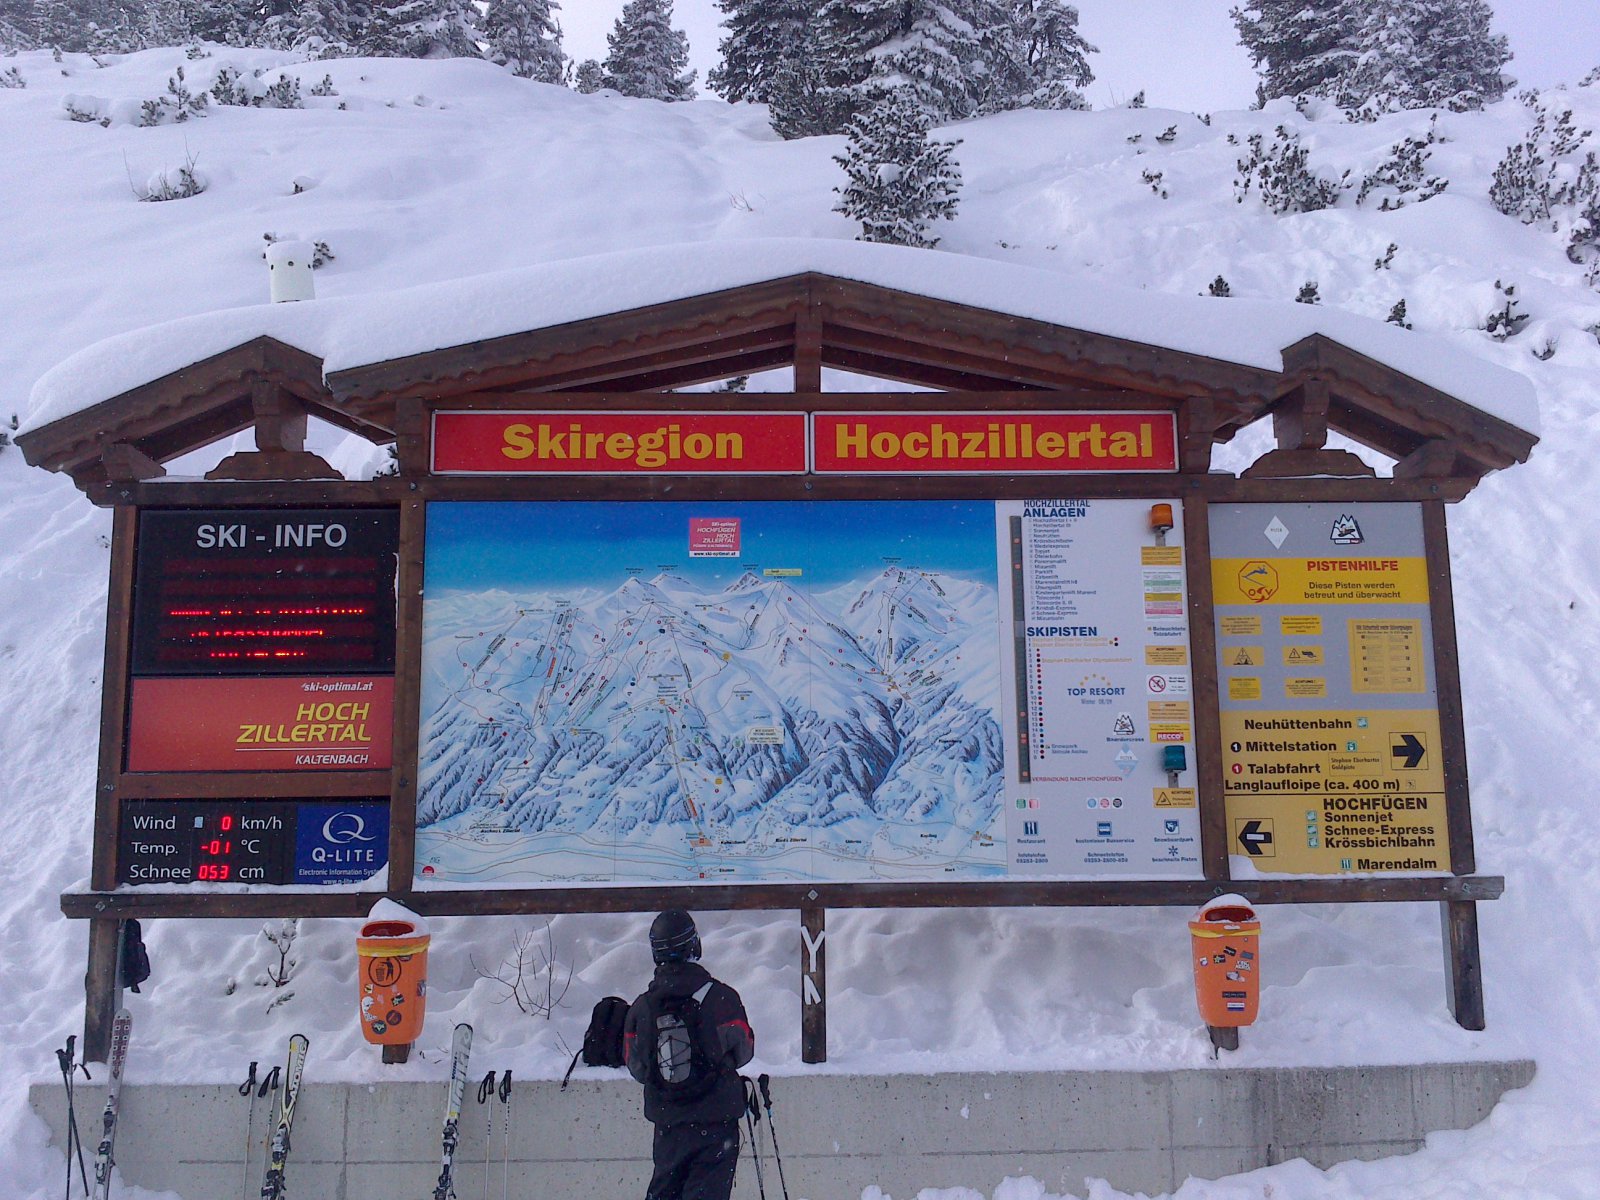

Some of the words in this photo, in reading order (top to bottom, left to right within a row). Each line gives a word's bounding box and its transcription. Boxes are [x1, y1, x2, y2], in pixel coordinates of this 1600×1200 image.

[501, 423, 743, 468] Skiregion
[835, 423, 1153, 459] Hochzillertal
[1023, 499, 1091, 508] HOCHZILLERTAL
[1023, 508, 1086, 518] ANLAGEN
[196, 524, 247, 548] SKI
[275, 523, 348, 548] INFO
[1307, 560, 1399, 572] PISTENHILFE
[1309, 581, 1333, 589] Diese
[1335, 581, 1362, 589] Pisten
[1363, 581, 1396, 589] werden
[1304, 590, 1335, 599] betreut
[1337, 590, 1354, 599] und
[1355, 590, 1401, 599] überwacht
[1026, 626, 1098, 637] SKIPISTEN
[1067, 688, 1087, 696] TOP
[1089, 687, 1126, 696] RESORT
[296, 702, 370, 722] HOCH
[1244, 718, 1353, 730] Neuhüttenbahn
[236, 723, 372, 743] ZILLERTAL
[1246, 741, 1337, 752] Mittelstation
[295, 754, 369, 765] KALTENBACH
[1248, 763, 1321, 774] Talabfahrt
[1225, 779, 1321, 792] Langlaufloipe
[1324, 779, 1350, 791] (ca.
[1353, 779, 1380, 790] 400
[1383, 779, 1400, 791] m)
[1323, 795, 1428, 811] HOCHFÜGEN
[133, 815, 176, 830] Wind
[221, 815, 232, 831] 0
[241, 815, 283, 830] km/h
[1324, 811, 1394, 824] Sonnenjet
[1325, 824, 1435, 838] Schnee-Express
[131, 841, 179, 856] Temp.
[201, 840, 231, 855] -01
[240, 839, 260, 854] °C
[1325, 836, 1436, 848] Krössbichlbahn
[311, 847, 374, 863] Q-LITE
[1357, 858, 1437, 870] Marendalm
[129, 864, 191, 879] Schnee
[198, 865, 230, 880] 053
[239, 867, 264, 879] cm
[298, 868, 328, 876] Electronic
[329, 868, 363, 876] Information
